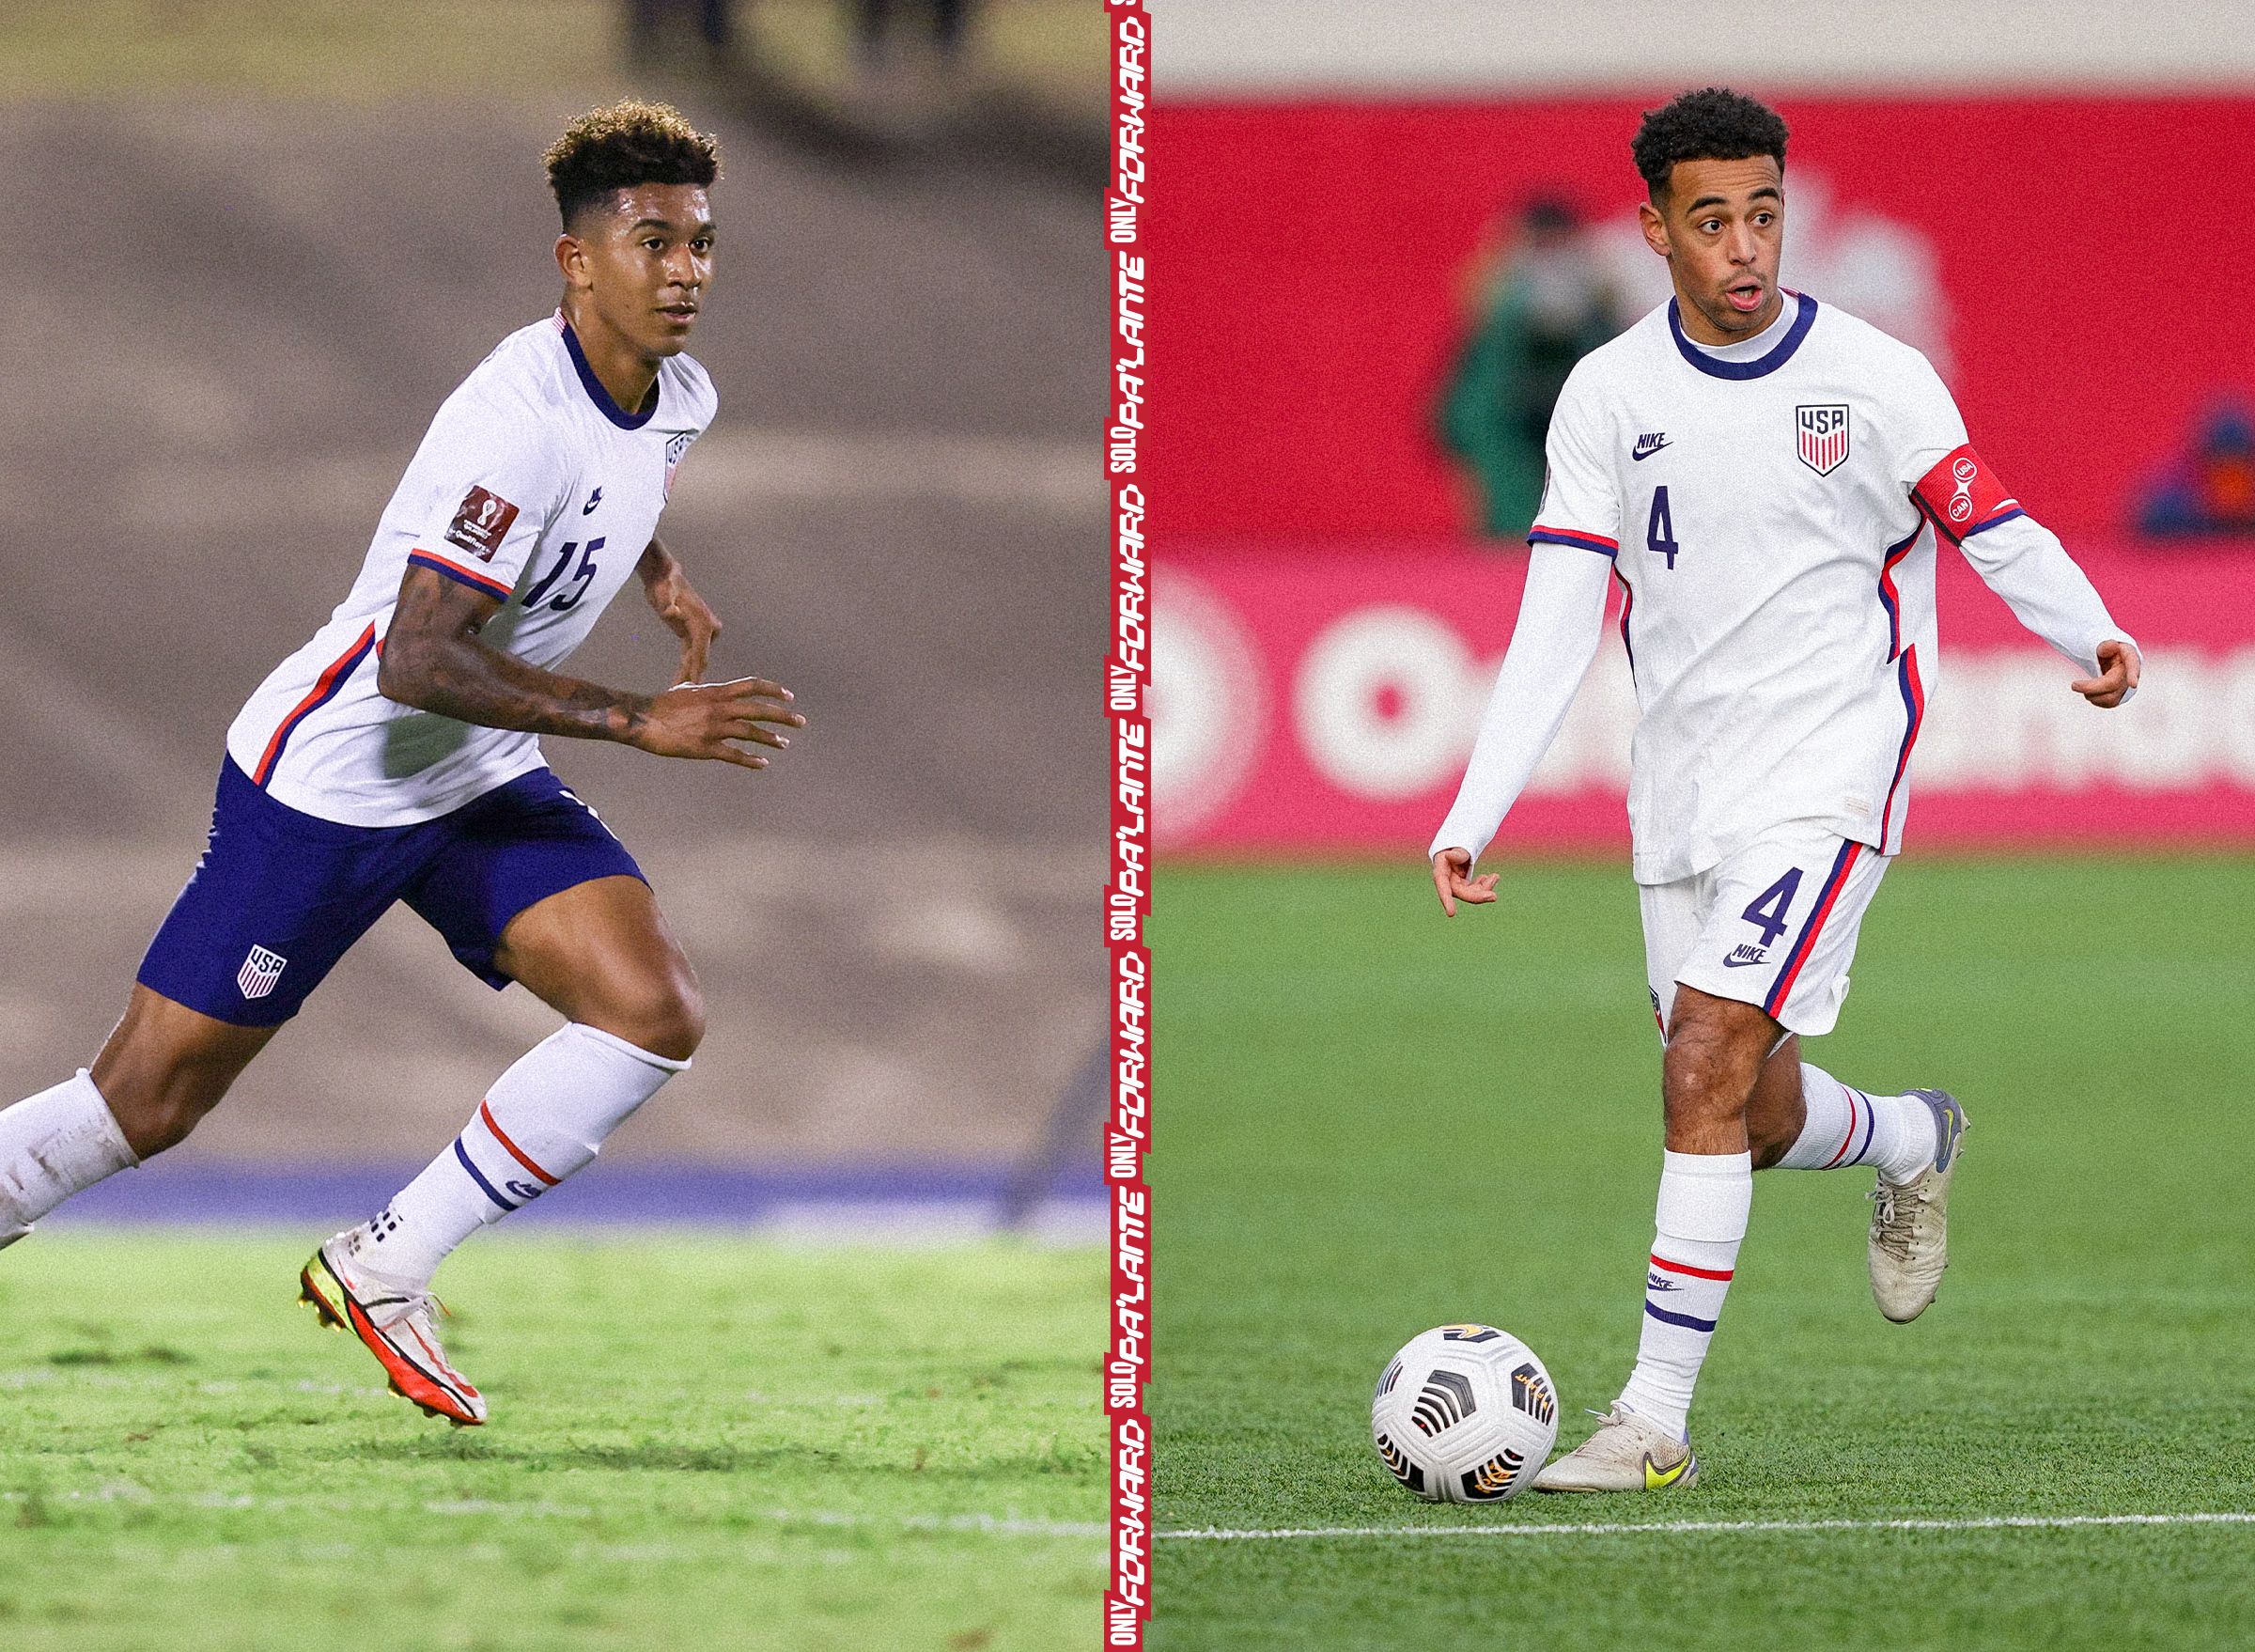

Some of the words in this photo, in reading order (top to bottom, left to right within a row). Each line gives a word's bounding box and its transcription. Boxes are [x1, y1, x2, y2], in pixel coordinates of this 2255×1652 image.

[1801, 410, 1843, 435] USA
[1637, 432, 1665, 449] NIKE
[1956, 462, 1973, 476] USA
[1952, 500, 1969, 518] CAN
[1647, 486, 1678, 570] 4
[521, 537, 606, 611] 15
[1741, 866, 1804, 948] 4
[251, 948, 284, 974] USA
[1732, 943, 1766, 962] NIKE
